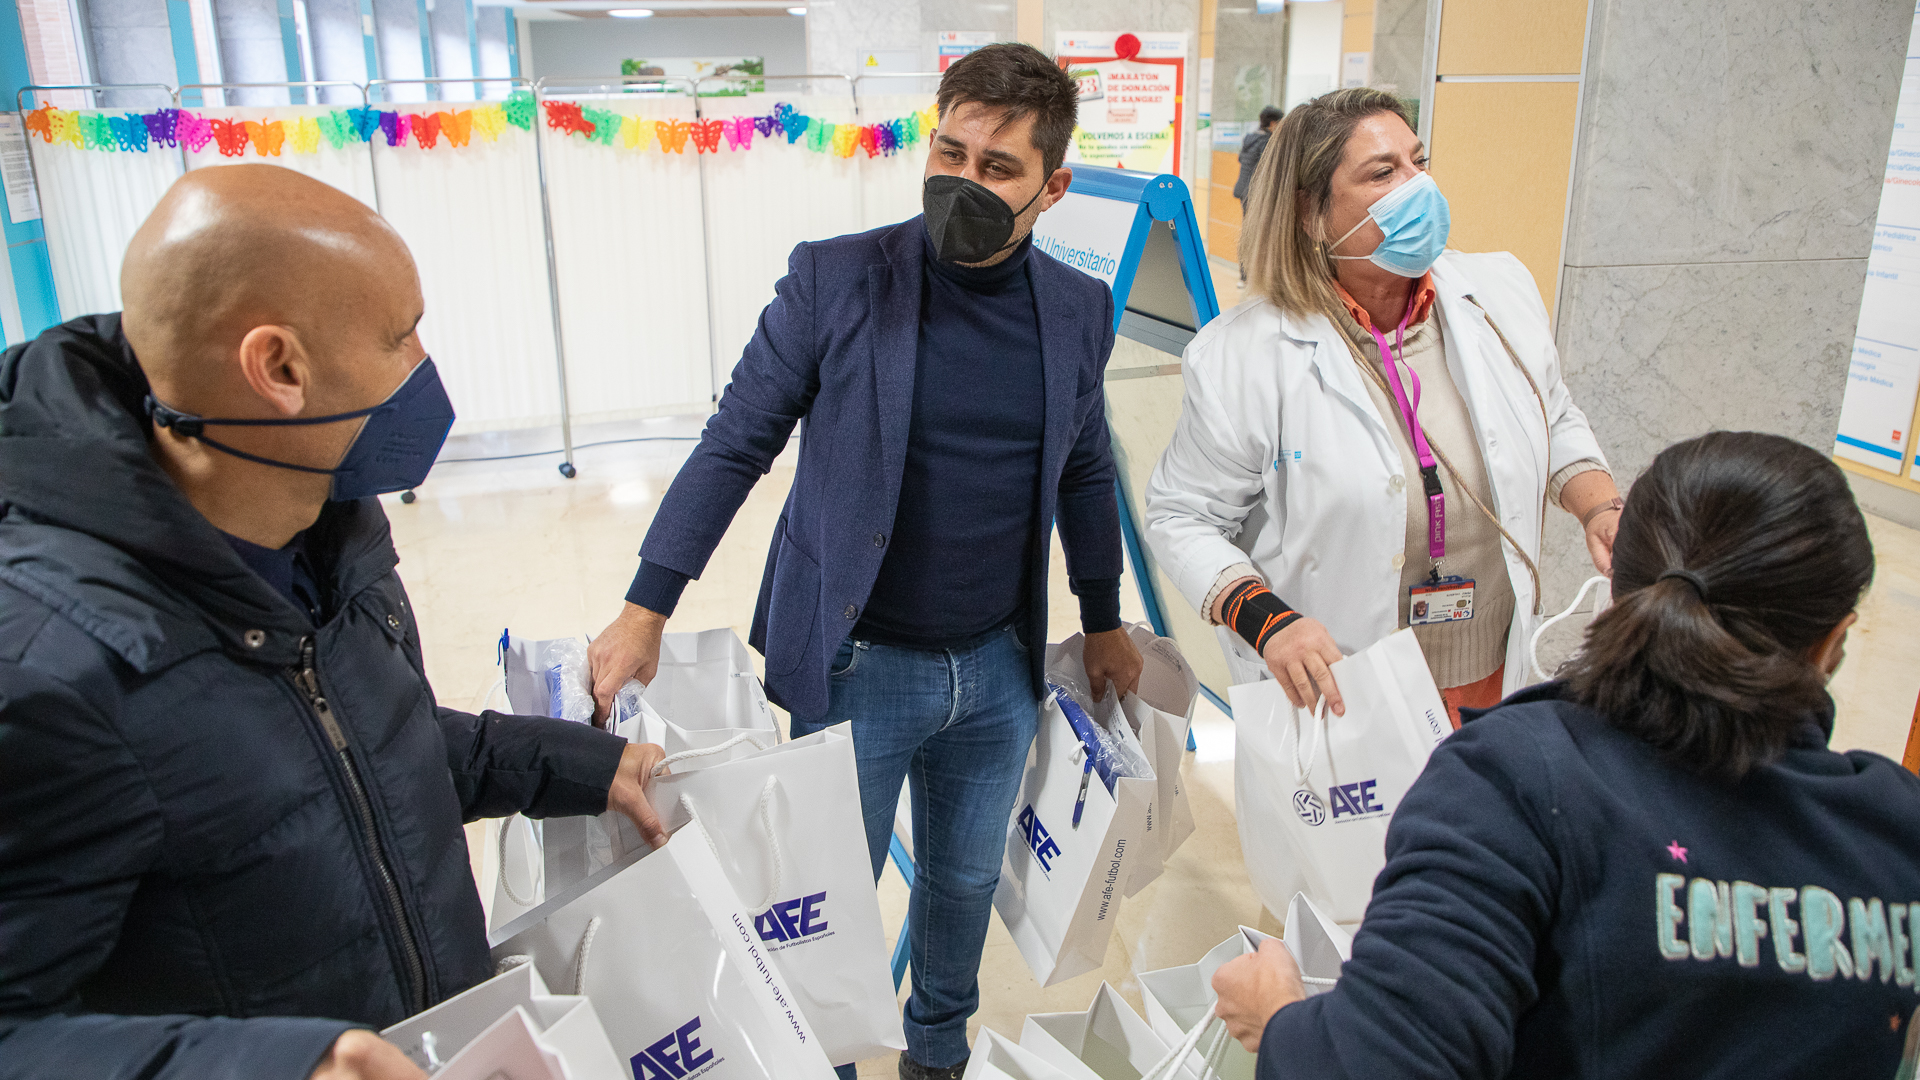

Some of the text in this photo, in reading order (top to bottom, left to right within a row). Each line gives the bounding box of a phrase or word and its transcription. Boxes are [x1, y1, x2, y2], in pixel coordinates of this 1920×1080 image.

[1045, 236, 1116, 276] Universitario
[1328, 778, 1384, 819] AFE
[1016, 803, 1062, 872] AFE
[1097, 838, 1127, 921] www.afe-futbol.com
[754, 891, 828, 942] AFE
[732, 912, 807, 1044] www.afe-futbol.com
[629, 1015, 715, 1080] AFE
